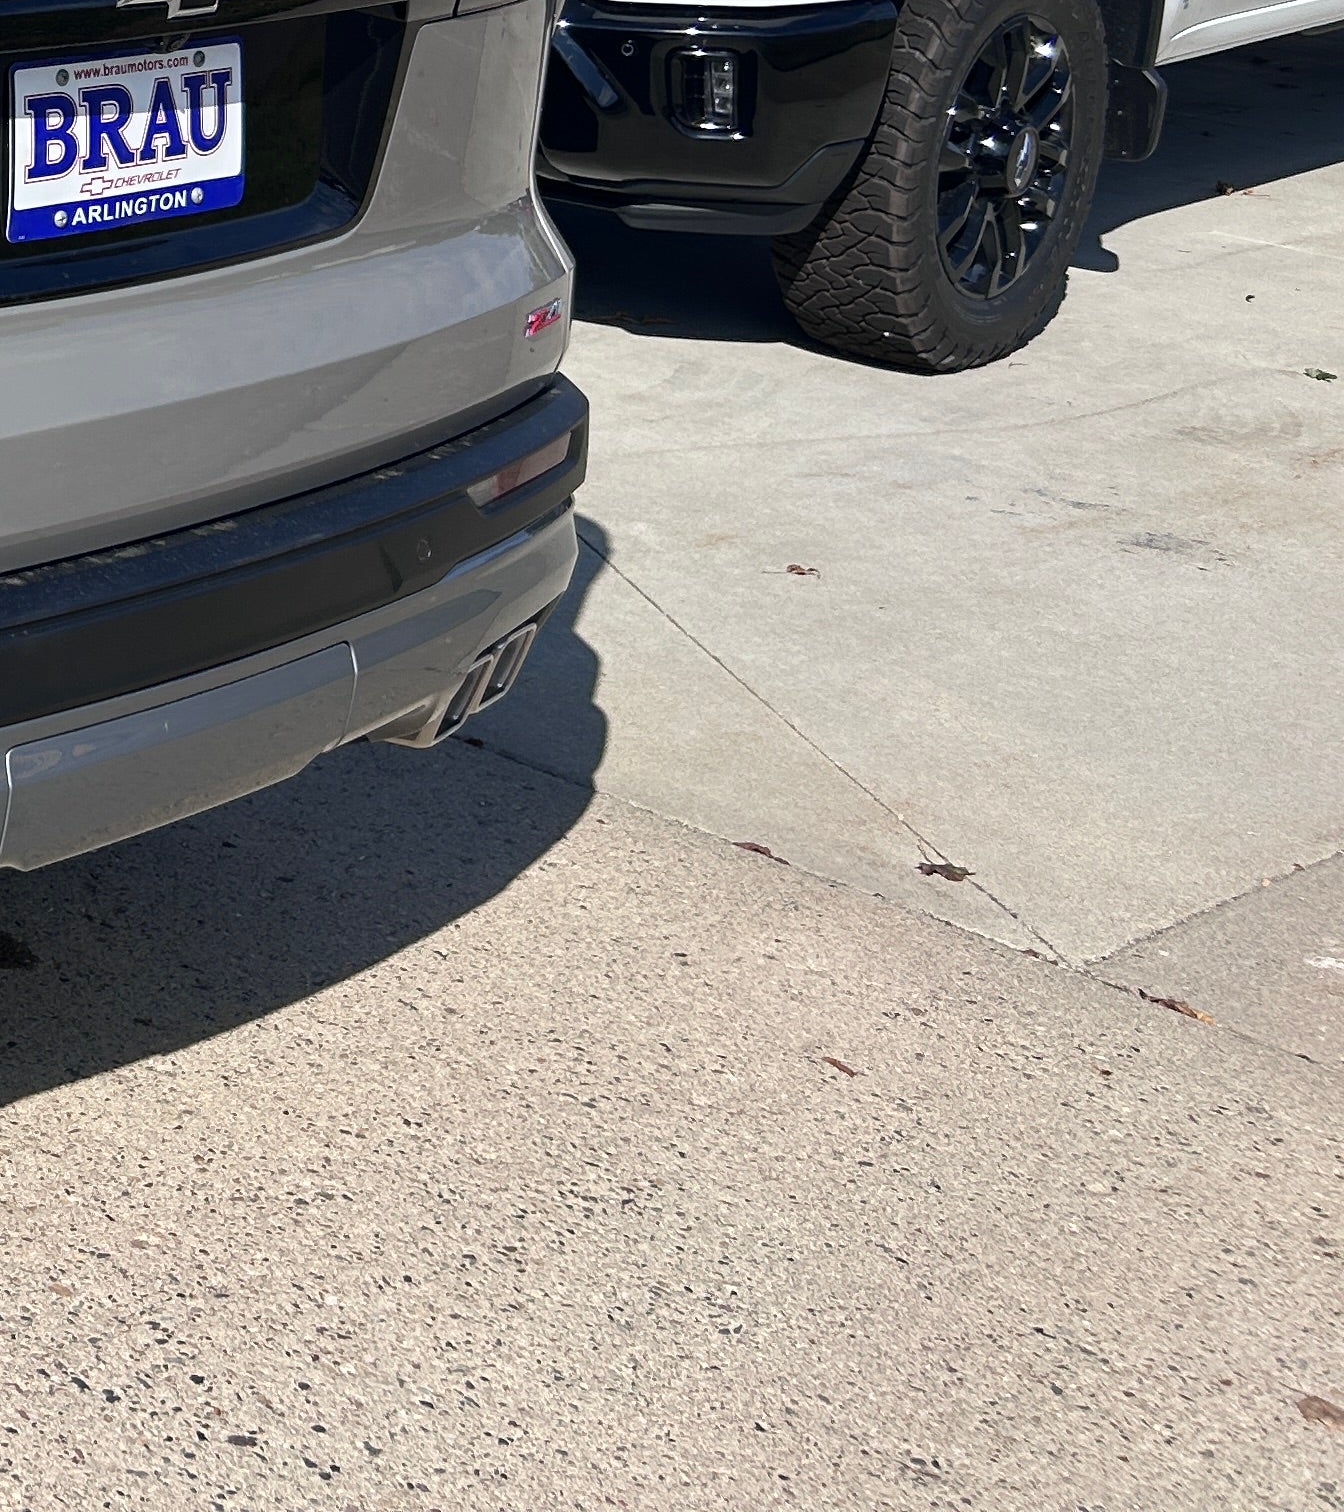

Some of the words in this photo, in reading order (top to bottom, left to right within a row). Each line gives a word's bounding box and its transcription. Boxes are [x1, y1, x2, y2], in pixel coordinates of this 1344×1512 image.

[73, 55, 189, 81] www.braumotors.com
[24, 68, 232, 184] BRAU
[114, 168, 182, 189] CHEVROLET
[71, 189, 187, 226] ARLINGTON
